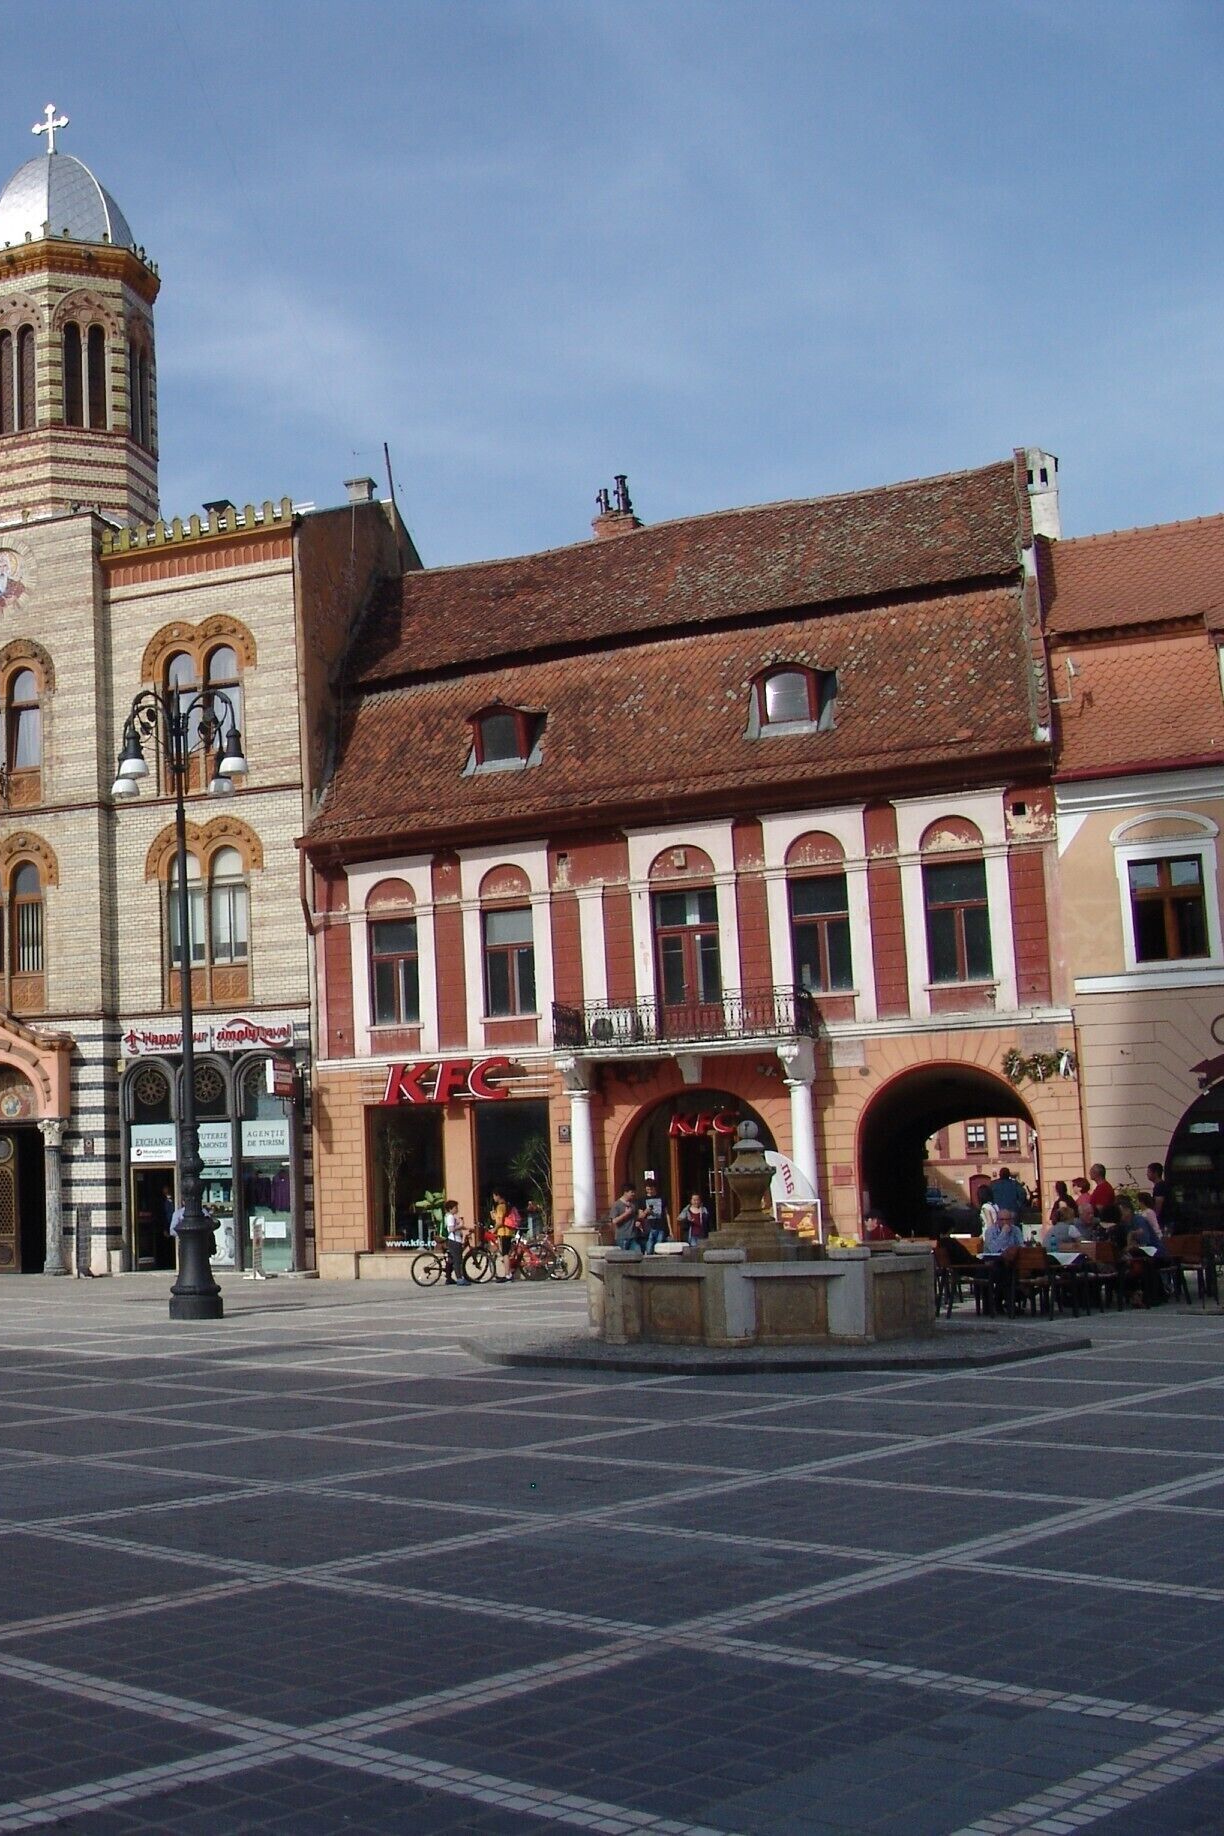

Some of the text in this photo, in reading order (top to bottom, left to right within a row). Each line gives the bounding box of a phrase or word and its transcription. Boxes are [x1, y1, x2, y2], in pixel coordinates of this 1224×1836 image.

[379, 1056, 510, 1105] KFC
[668, 1112, 735, 1136] KFC
[135, 1137, 173, 1147] EXCHANGE
[247, 1138, 285, 1147] DE TURISM
[386, 1239, 437, 1248] www.kfc.ro
